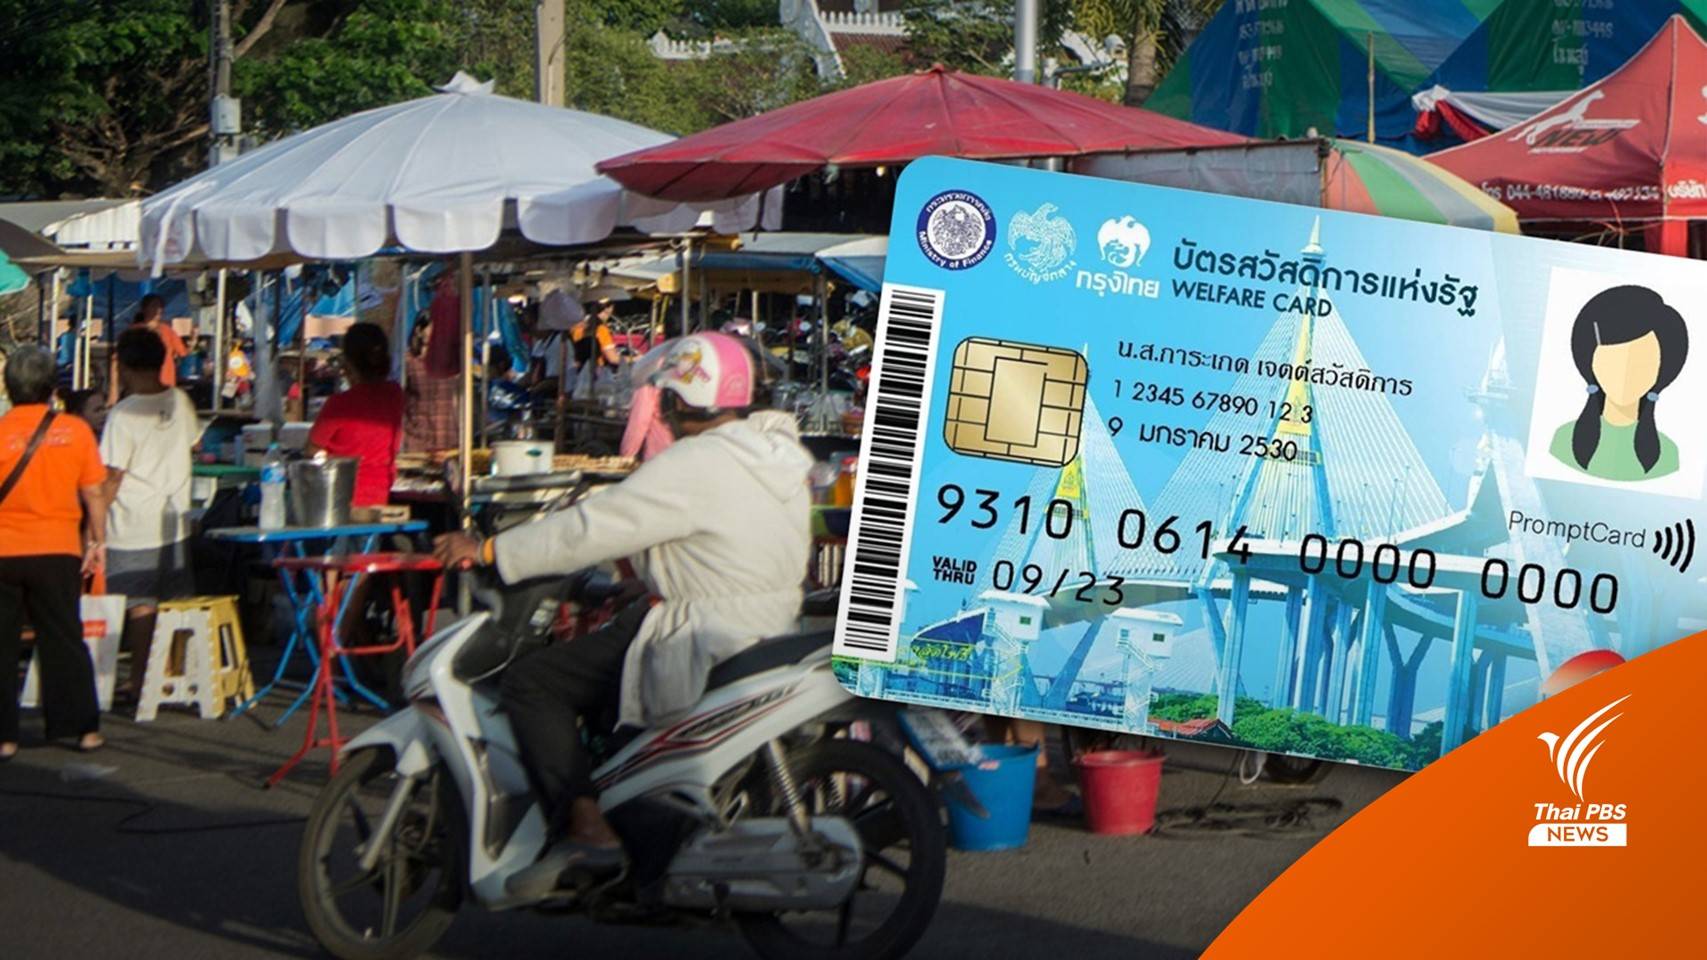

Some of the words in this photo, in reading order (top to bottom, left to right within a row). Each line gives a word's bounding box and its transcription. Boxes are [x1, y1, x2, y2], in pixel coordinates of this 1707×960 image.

[918, 230, 947, 267] Ministry
[962, 240, 993, 268] Finance
[1075, 269, 1160, 299] กรุงไทย
[1172, 238, 1480, 317] บัตรสวัสดิการแห่งรัฐ
[1171, 278, 1266, 309] WELFARE
[1273, 293, 1333, 317] CARD
[1118, 340, 1250, 375] น.ส.การะเกด
[1113, 379, 1122, 398] 1
[1132, 382, 1185, 406] 2345
[1192, 390, 1259, 416] 67890
[1268, 400, 1291, 422] 12
[1300, 405, 1314, 424] 3
[1107, 416, 1123, 437] 9
[1139, 423, 1230, 453] มกราคม
[1239, 434, 1299, 462] 2530
[937, 483, 1073, 540] 9310
[1117, 508, 1251, 565] 0614
[1299, 533, 1437, 589] 0000
[1481, 558, 1619, 614] 0000
[1508, 510, 1647, 549] PromptCard
[932, 555, 977, 573] VALID
[933, 568, 976, 585] THRU
[992, 560, 1126, 606] 09/23
